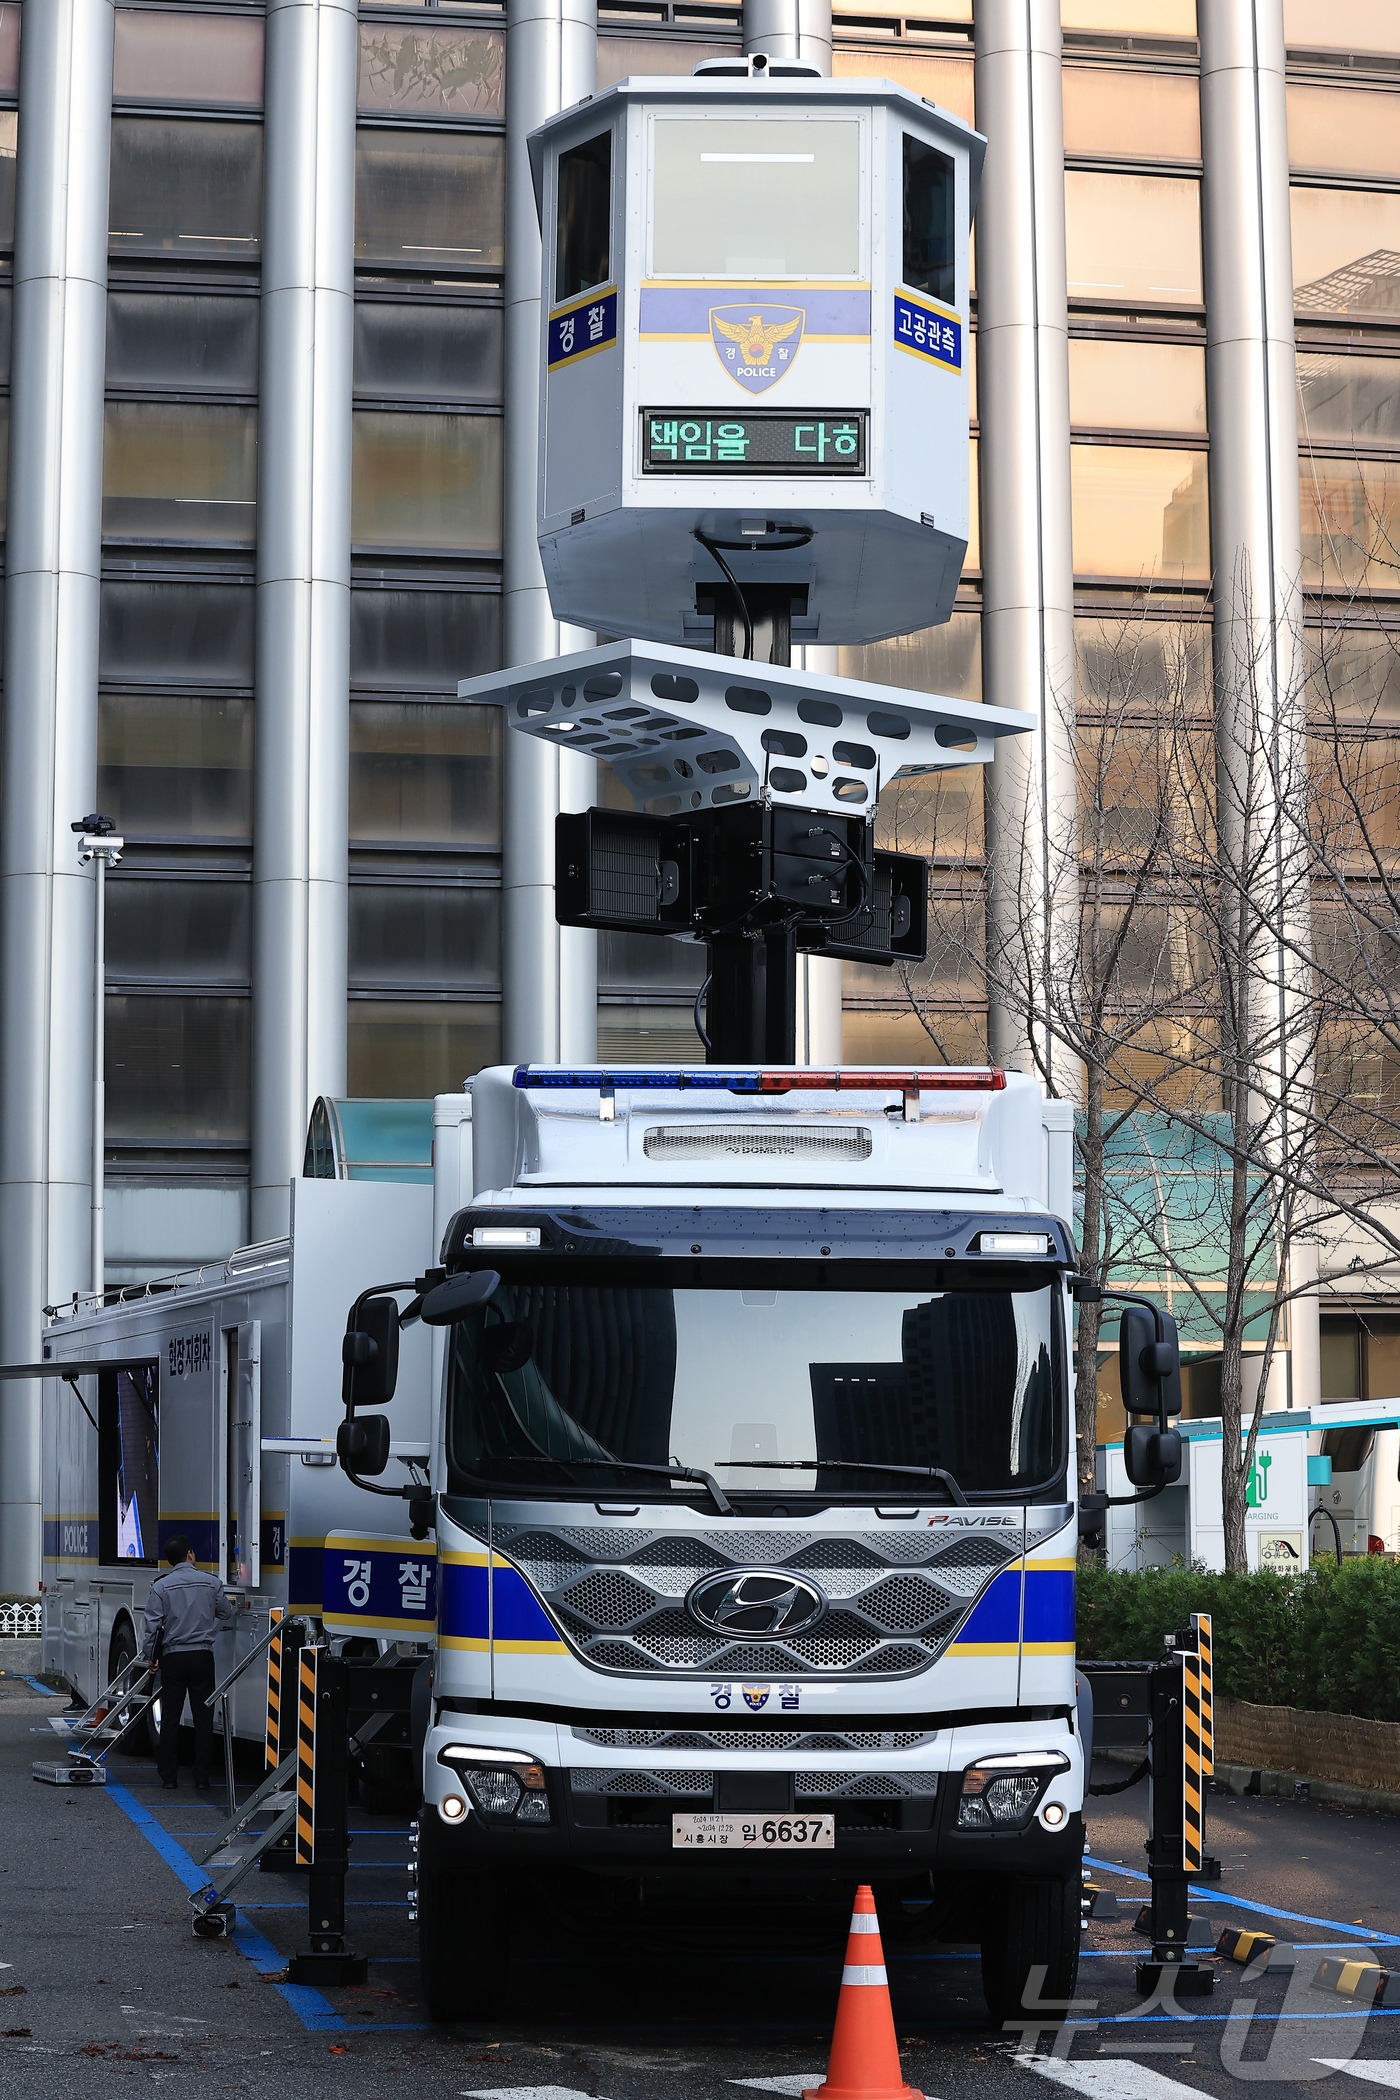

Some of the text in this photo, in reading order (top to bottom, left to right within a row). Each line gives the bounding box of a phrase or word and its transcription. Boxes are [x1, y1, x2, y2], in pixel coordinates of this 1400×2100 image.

[559, 304, 606, 353] 경 찰
[898, 307, 956, 358] 고공관측
[725, 347, 790, 360] 경 찰
[736, 367, 777, 377] POLICE
[650, 420, 750, 460] 책임을
[742, 1147, 795, 1155] DOMETIC
[168, 1331, 211, 1377] 현장지휘차
[927, 1514, 1019, 1527] PAVISE
[63, 1525, 89, 1554] POLICE
[272, 1526, 281, 1561] 경
[342, 1559, 432, 1610] 경 찰
[710, 1683, 803, 1710] 경 찰
[762, 1820, 823, 1843] 6637
